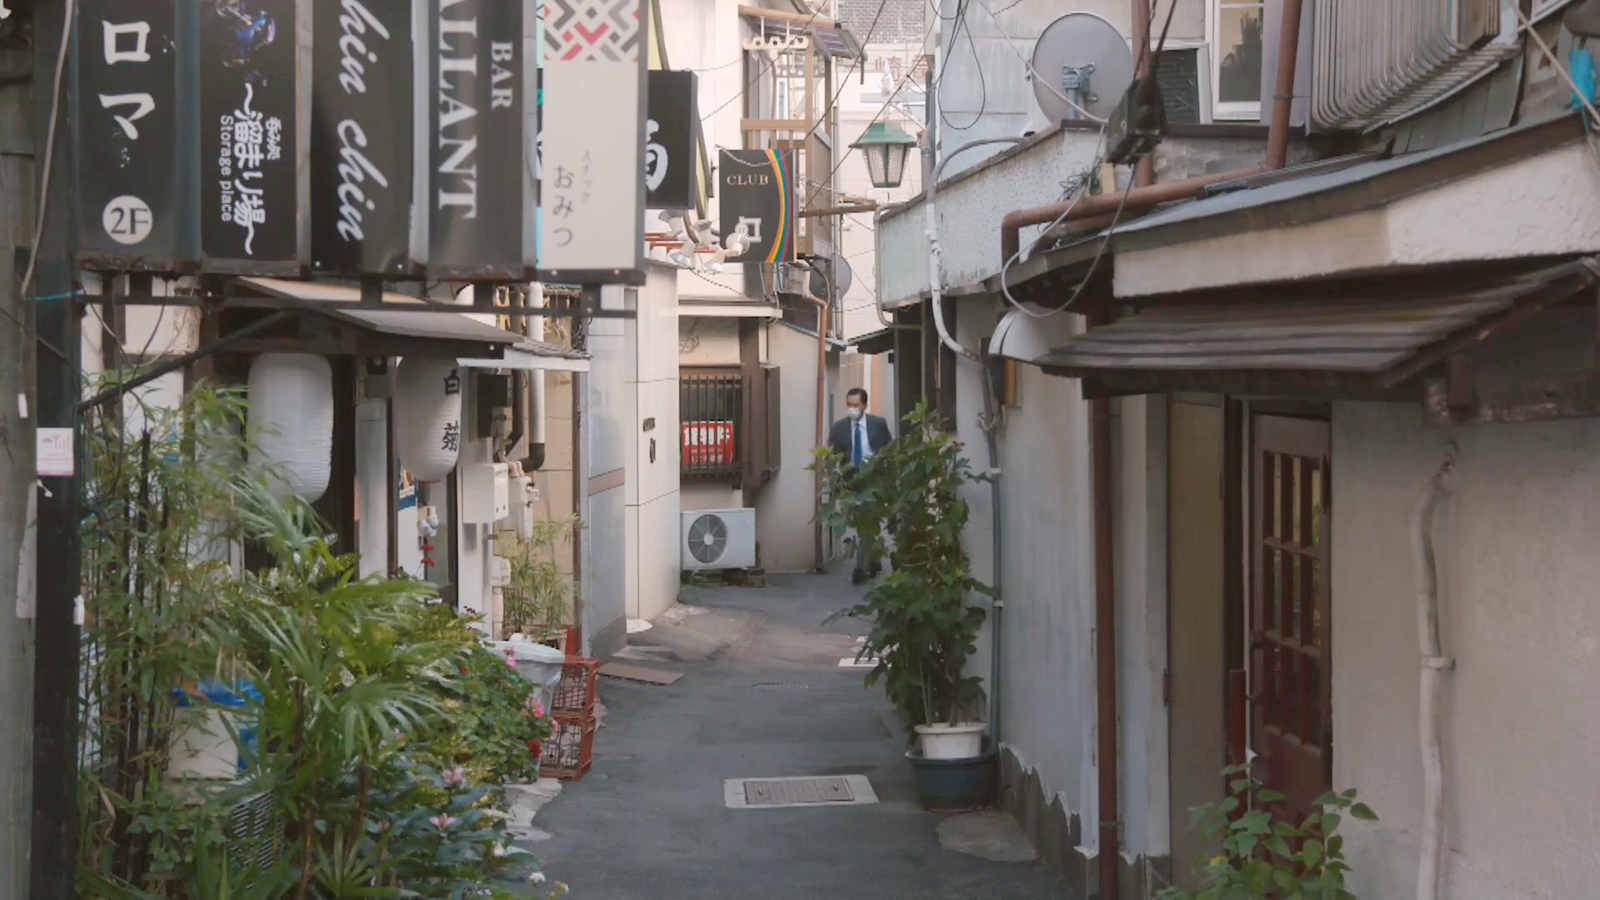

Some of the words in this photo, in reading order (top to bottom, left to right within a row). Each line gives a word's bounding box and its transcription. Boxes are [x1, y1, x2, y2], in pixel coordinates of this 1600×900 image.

[98, 20, 156, 141] ロマ
[490, 41, 514, 110] BAR
[218, 114, 235, 177] Storage
[726, 173, 769, 186] CLUB
[218, 180, 235, 223] place
[336, 119, 388, 242] chin
[552, 165, 574, 248] おみつ
[108, 206, 150, 236] 2F
[441, 368, 460, 452] 白菊
